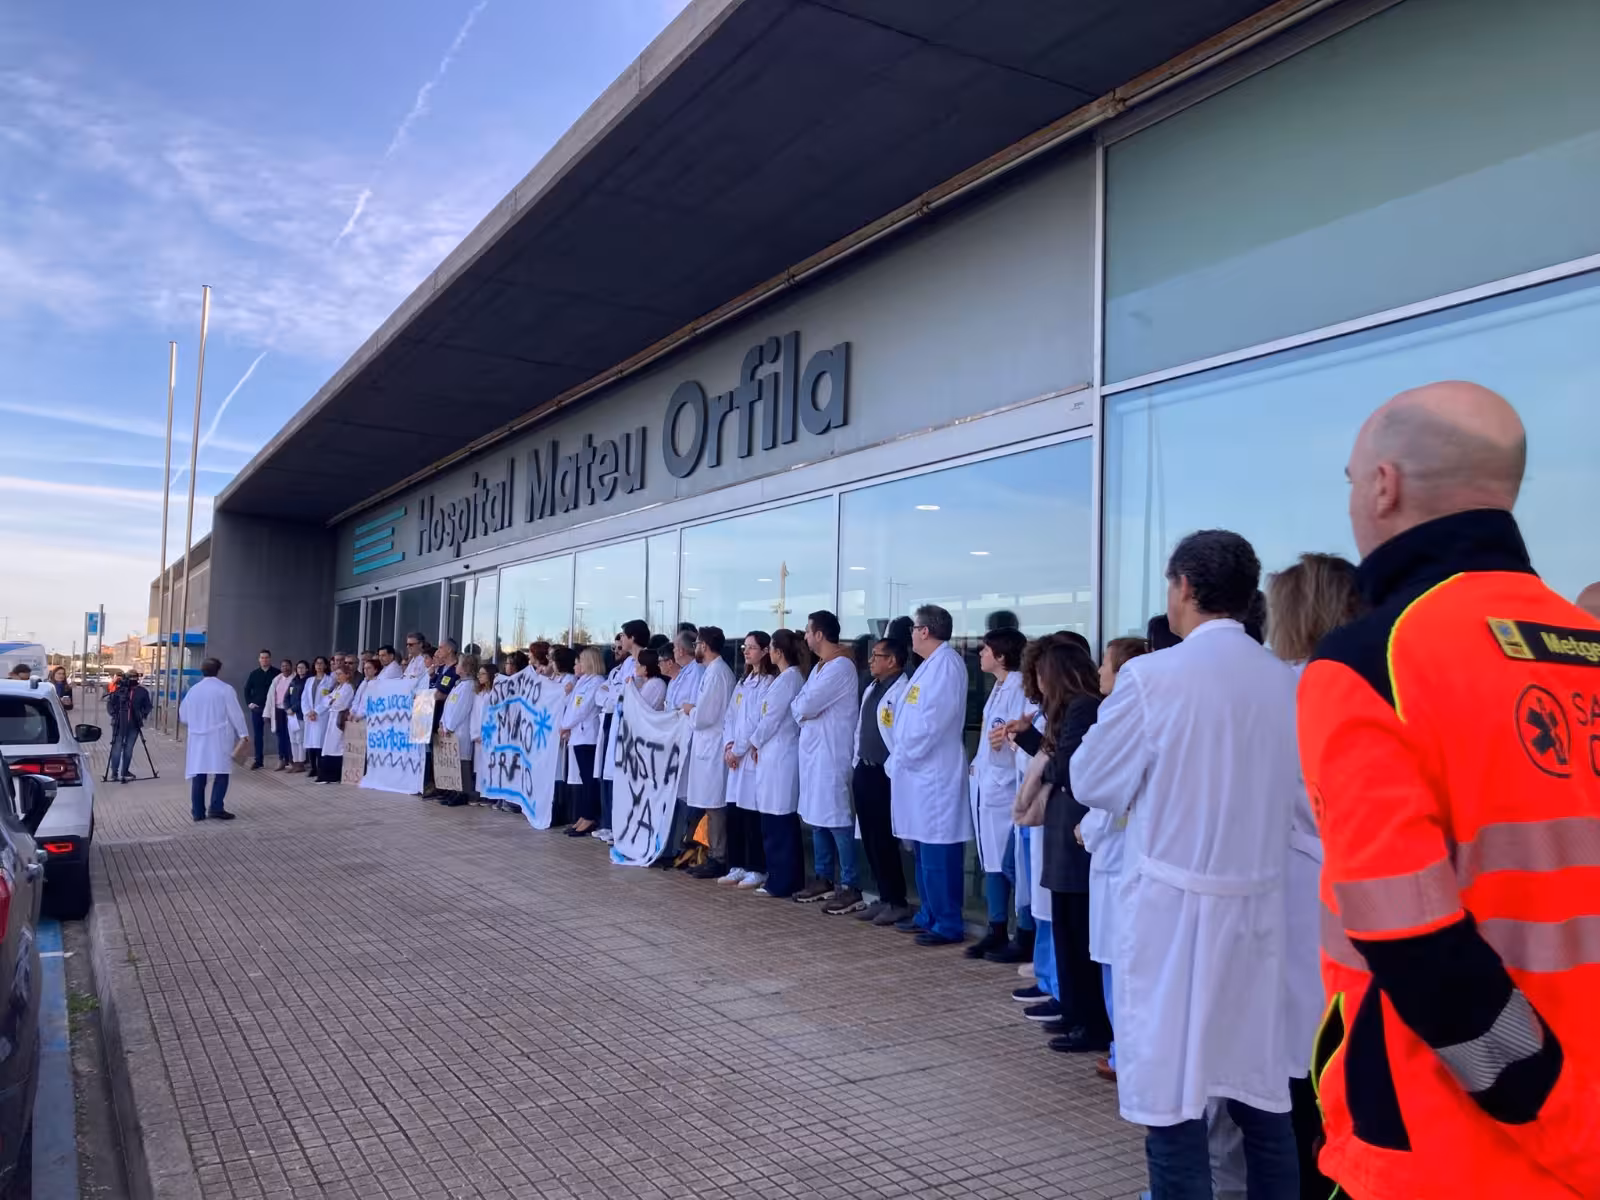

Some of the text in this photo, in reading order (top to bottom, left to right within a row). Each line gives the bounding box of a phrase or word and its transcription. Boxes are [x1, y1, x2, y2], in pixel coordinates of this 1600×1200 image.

[416, 330, 852, 557] Hospital Mateu Orfila
